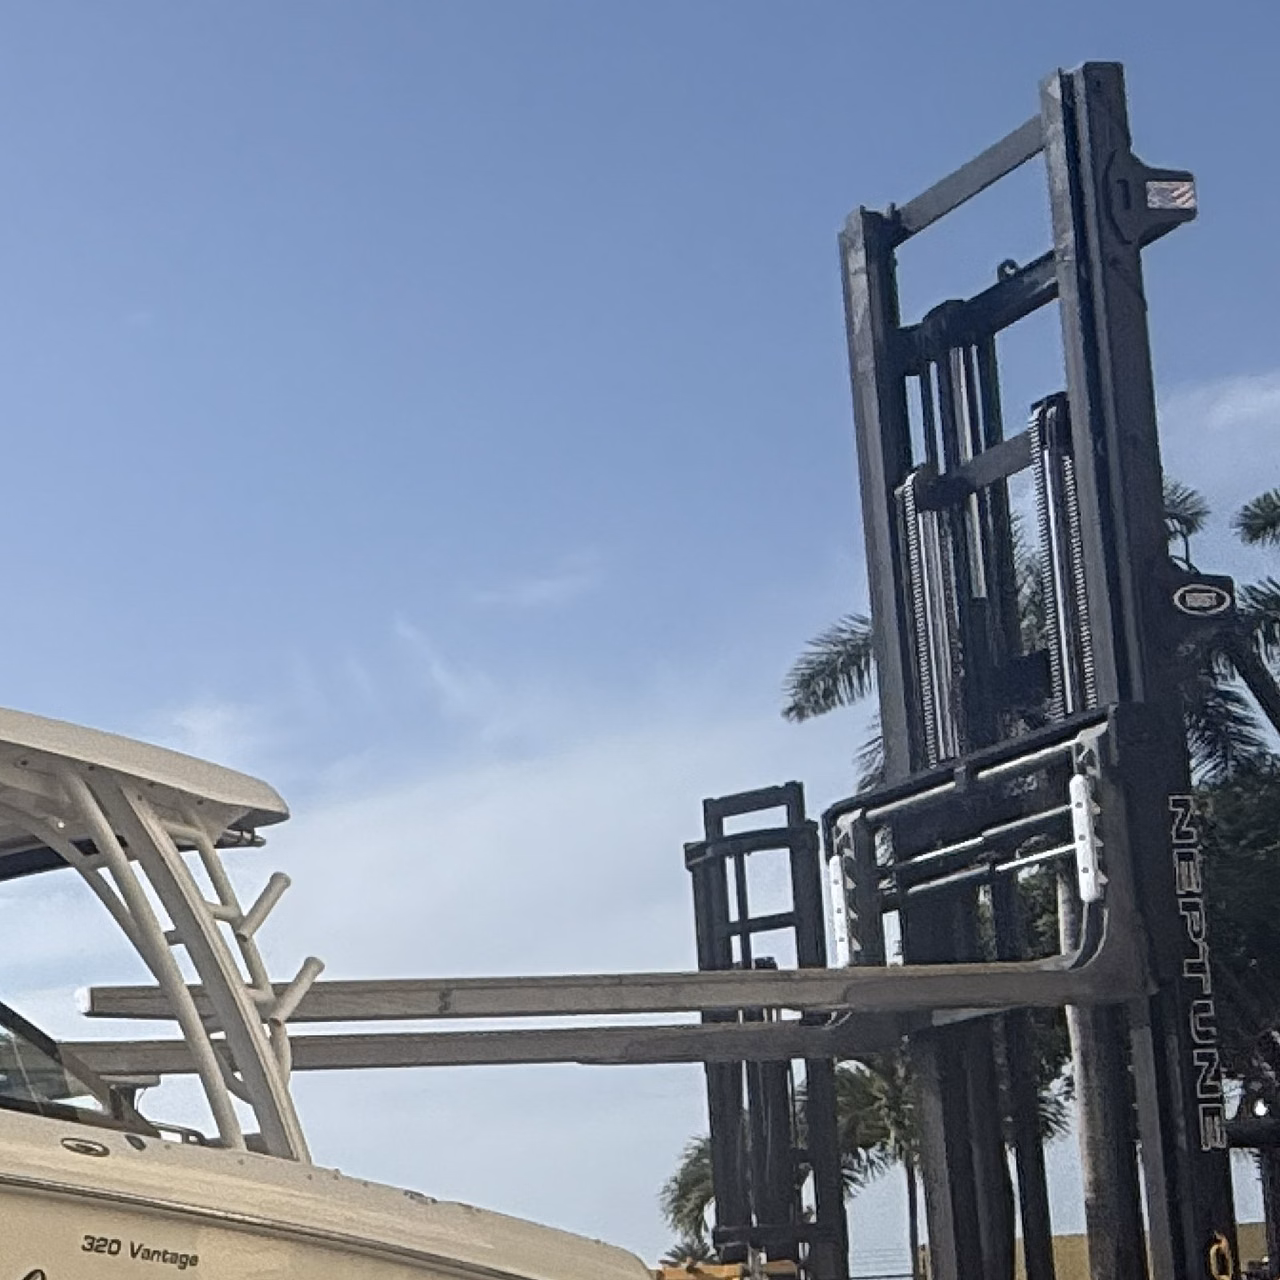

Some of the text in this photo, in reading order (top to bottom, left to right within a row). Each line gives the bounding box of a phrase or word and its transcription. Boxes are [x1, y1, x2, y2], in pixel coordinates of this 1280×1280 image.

[1168, 795, 1227, 1151] NEPTUNE
[81, 1234, 200, 1270] 320 Vantage
